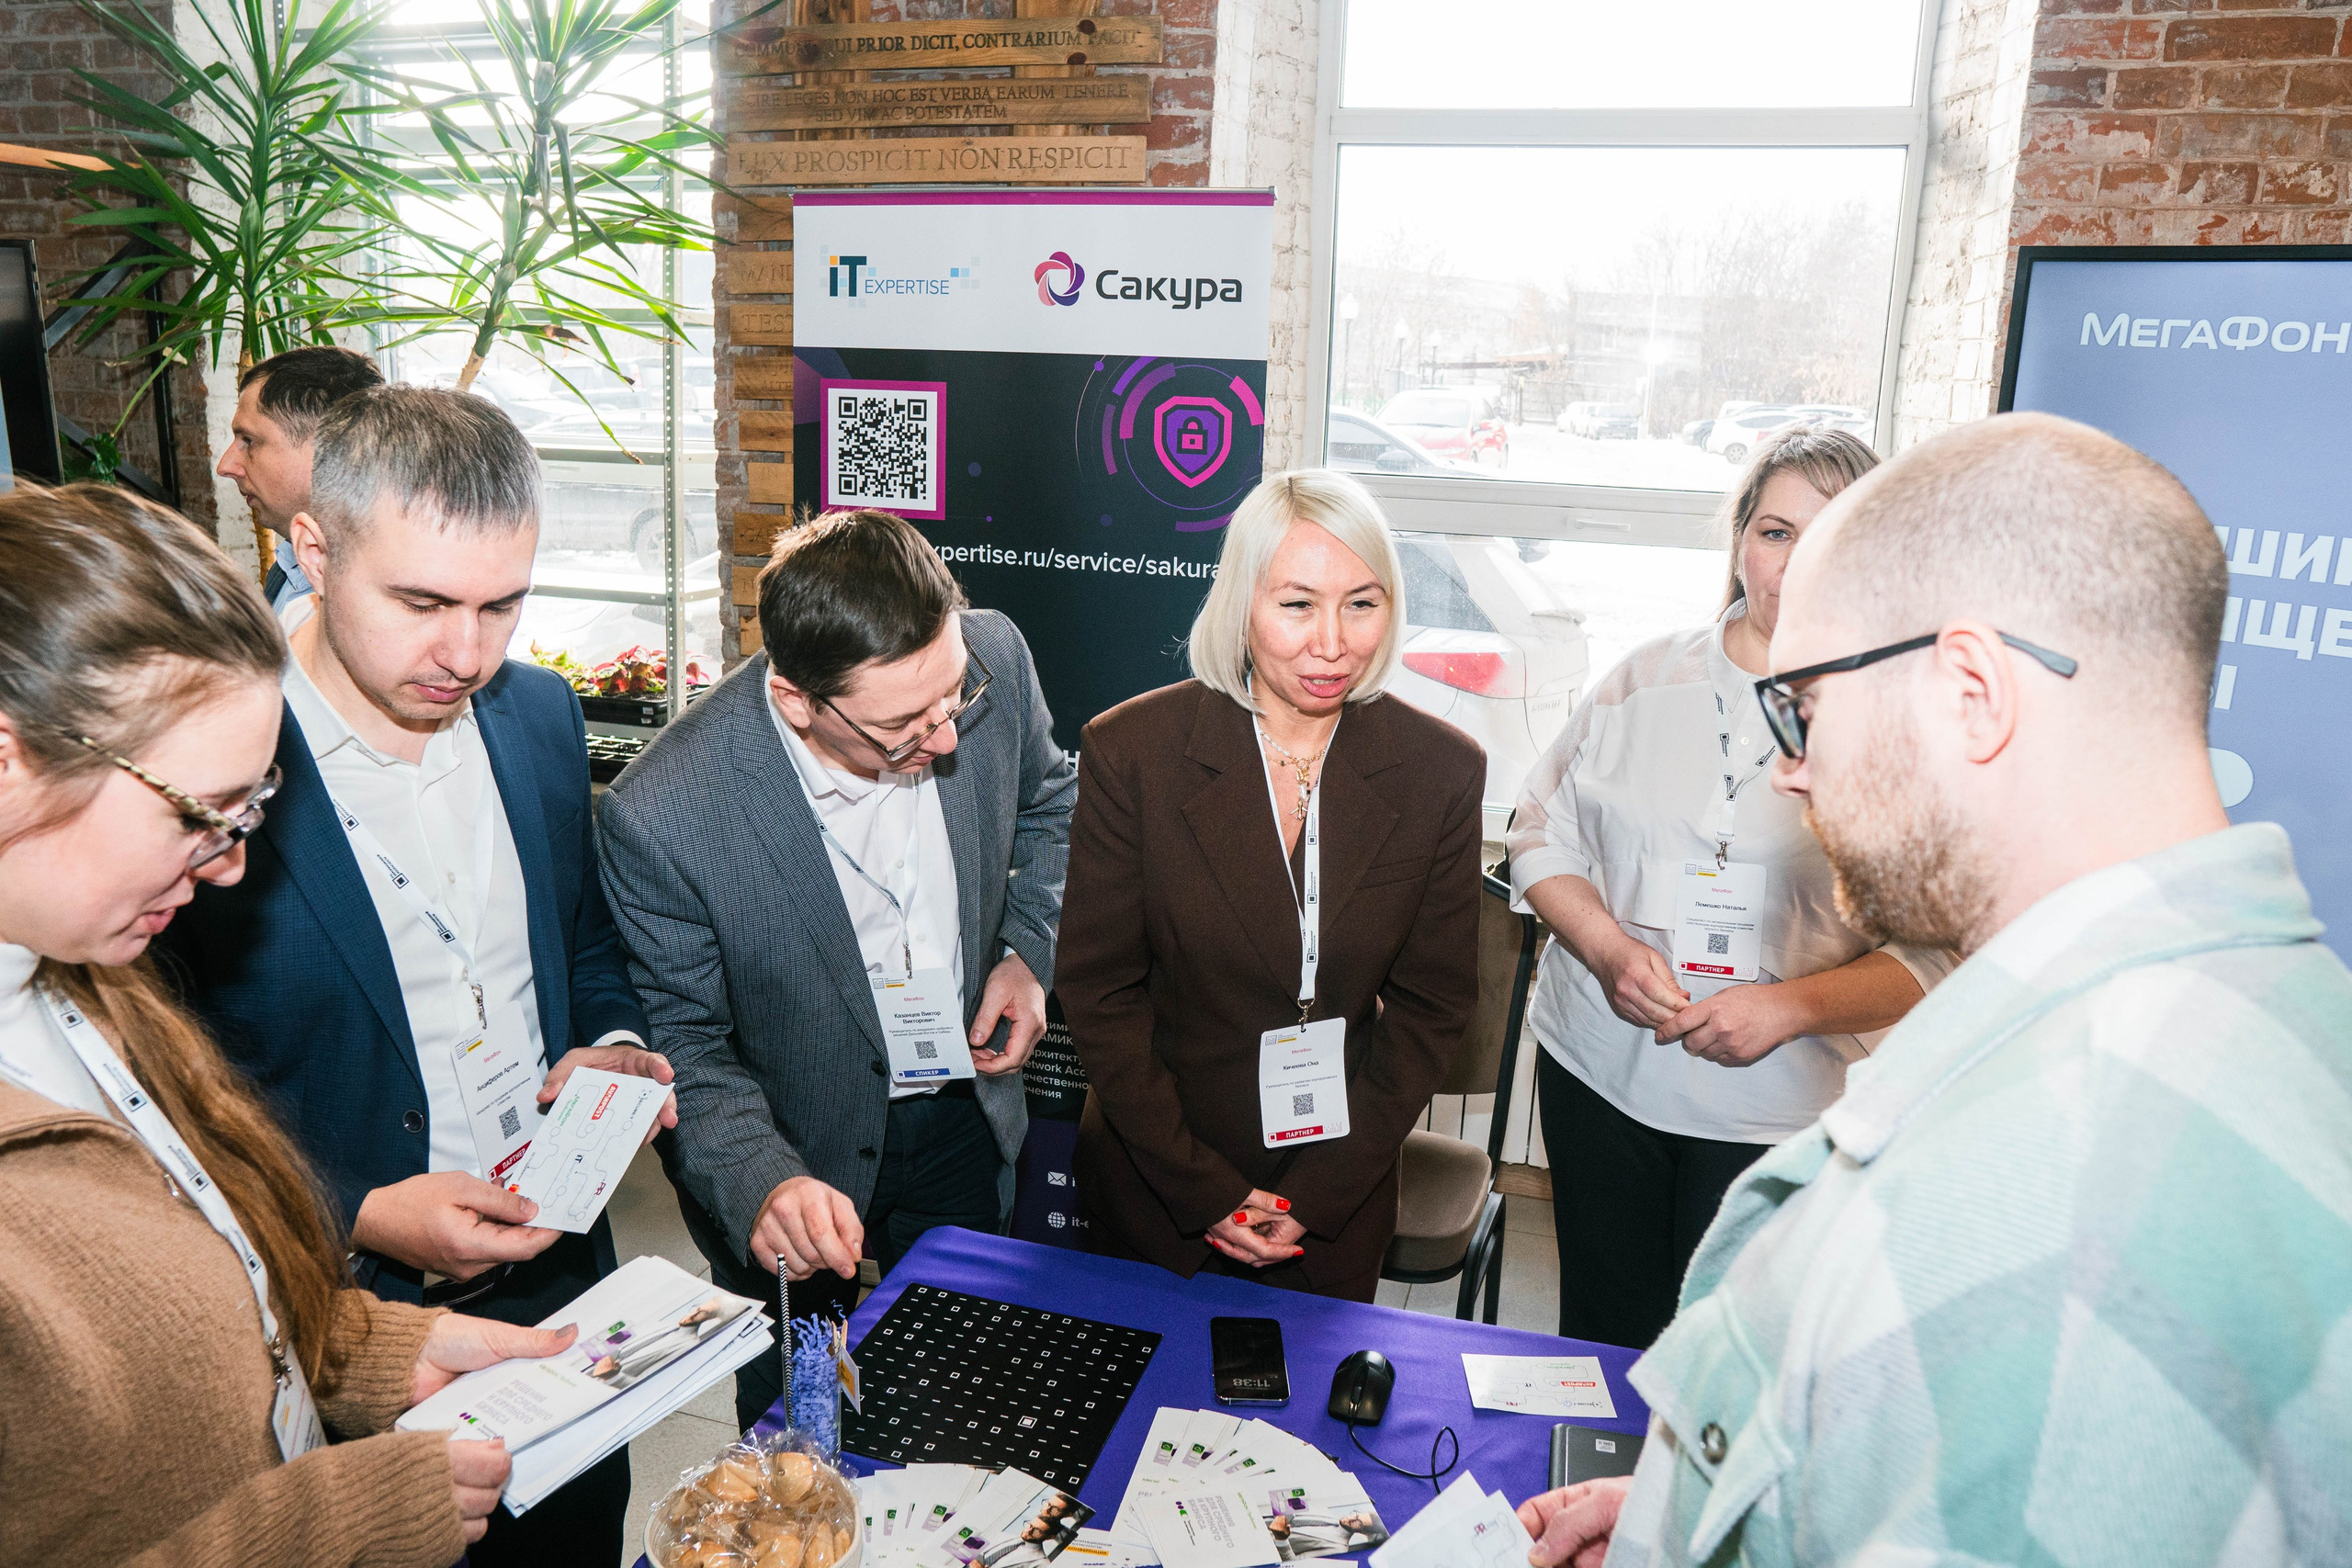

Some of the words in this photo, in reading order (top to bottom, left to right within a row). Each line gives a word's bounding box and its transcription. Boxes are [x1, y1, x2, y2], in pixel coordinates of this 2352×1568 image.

[857, 36, 907, 52] PRIOR
[911, 33, 959, 51] DICIT,
[963, 31, 1082, 49] CONTRARIUM
[1088, 28, 1139, 45] FACIT
[786, 92, 830, 107] LEGES
[835, 90, 867, 105] NON
[873, 89, 906, 103] HOC
[910, 87, 938, 102] EST
[942, 85, 992, 101] VERBA
[996, 85, 1056, 100] EARUM
[1063, 84, 1129, 98] TENERE
[816, 109, 842, 122] SED
[881, 107, 902, 120] AC
[905, 105, 1008, 119] POTESTATEM
[794, 149, 932, 173] PROSPICIT
[939, 147, 1001, 170] NON
[1008, 146, 1132, 169] RESPICIT
[865, 278, 950, 296] EXPERTISE
[1095, 269, 1243, 310] Сакура
[1696, 964, 1724, 973] ПАРТНЕР
[1286, 1128, 1315, 1138] ПАРТНЕР
[502, 1147, 526, 1169] ПАРТНЕР
[1232, 1378, 1271, 1387] 11:38
